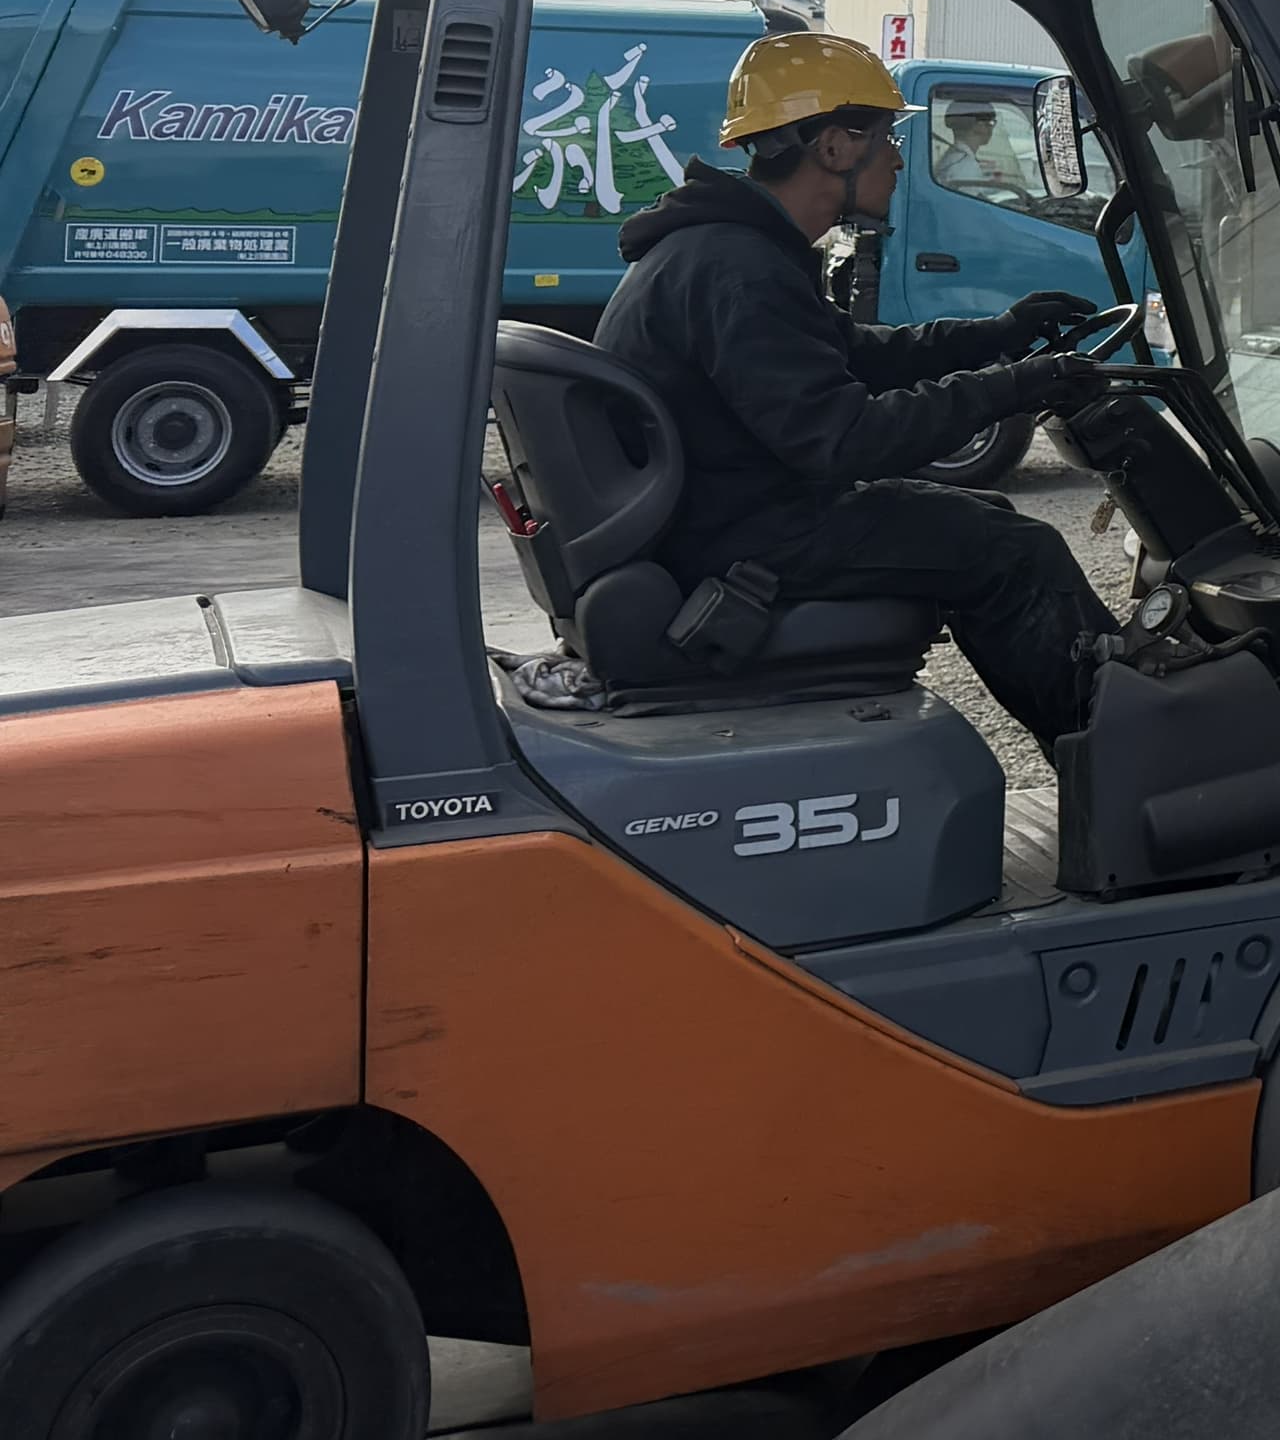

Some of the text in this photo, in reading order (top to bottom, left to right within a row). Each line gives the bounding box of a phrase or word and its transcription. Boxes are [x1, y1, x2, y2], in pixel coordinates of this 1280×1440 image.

[890, 17, 908, 60] タカ
[396, 795, 493, 821] TOYOTA
[623, 792, 900, 858] GENEO 35J
